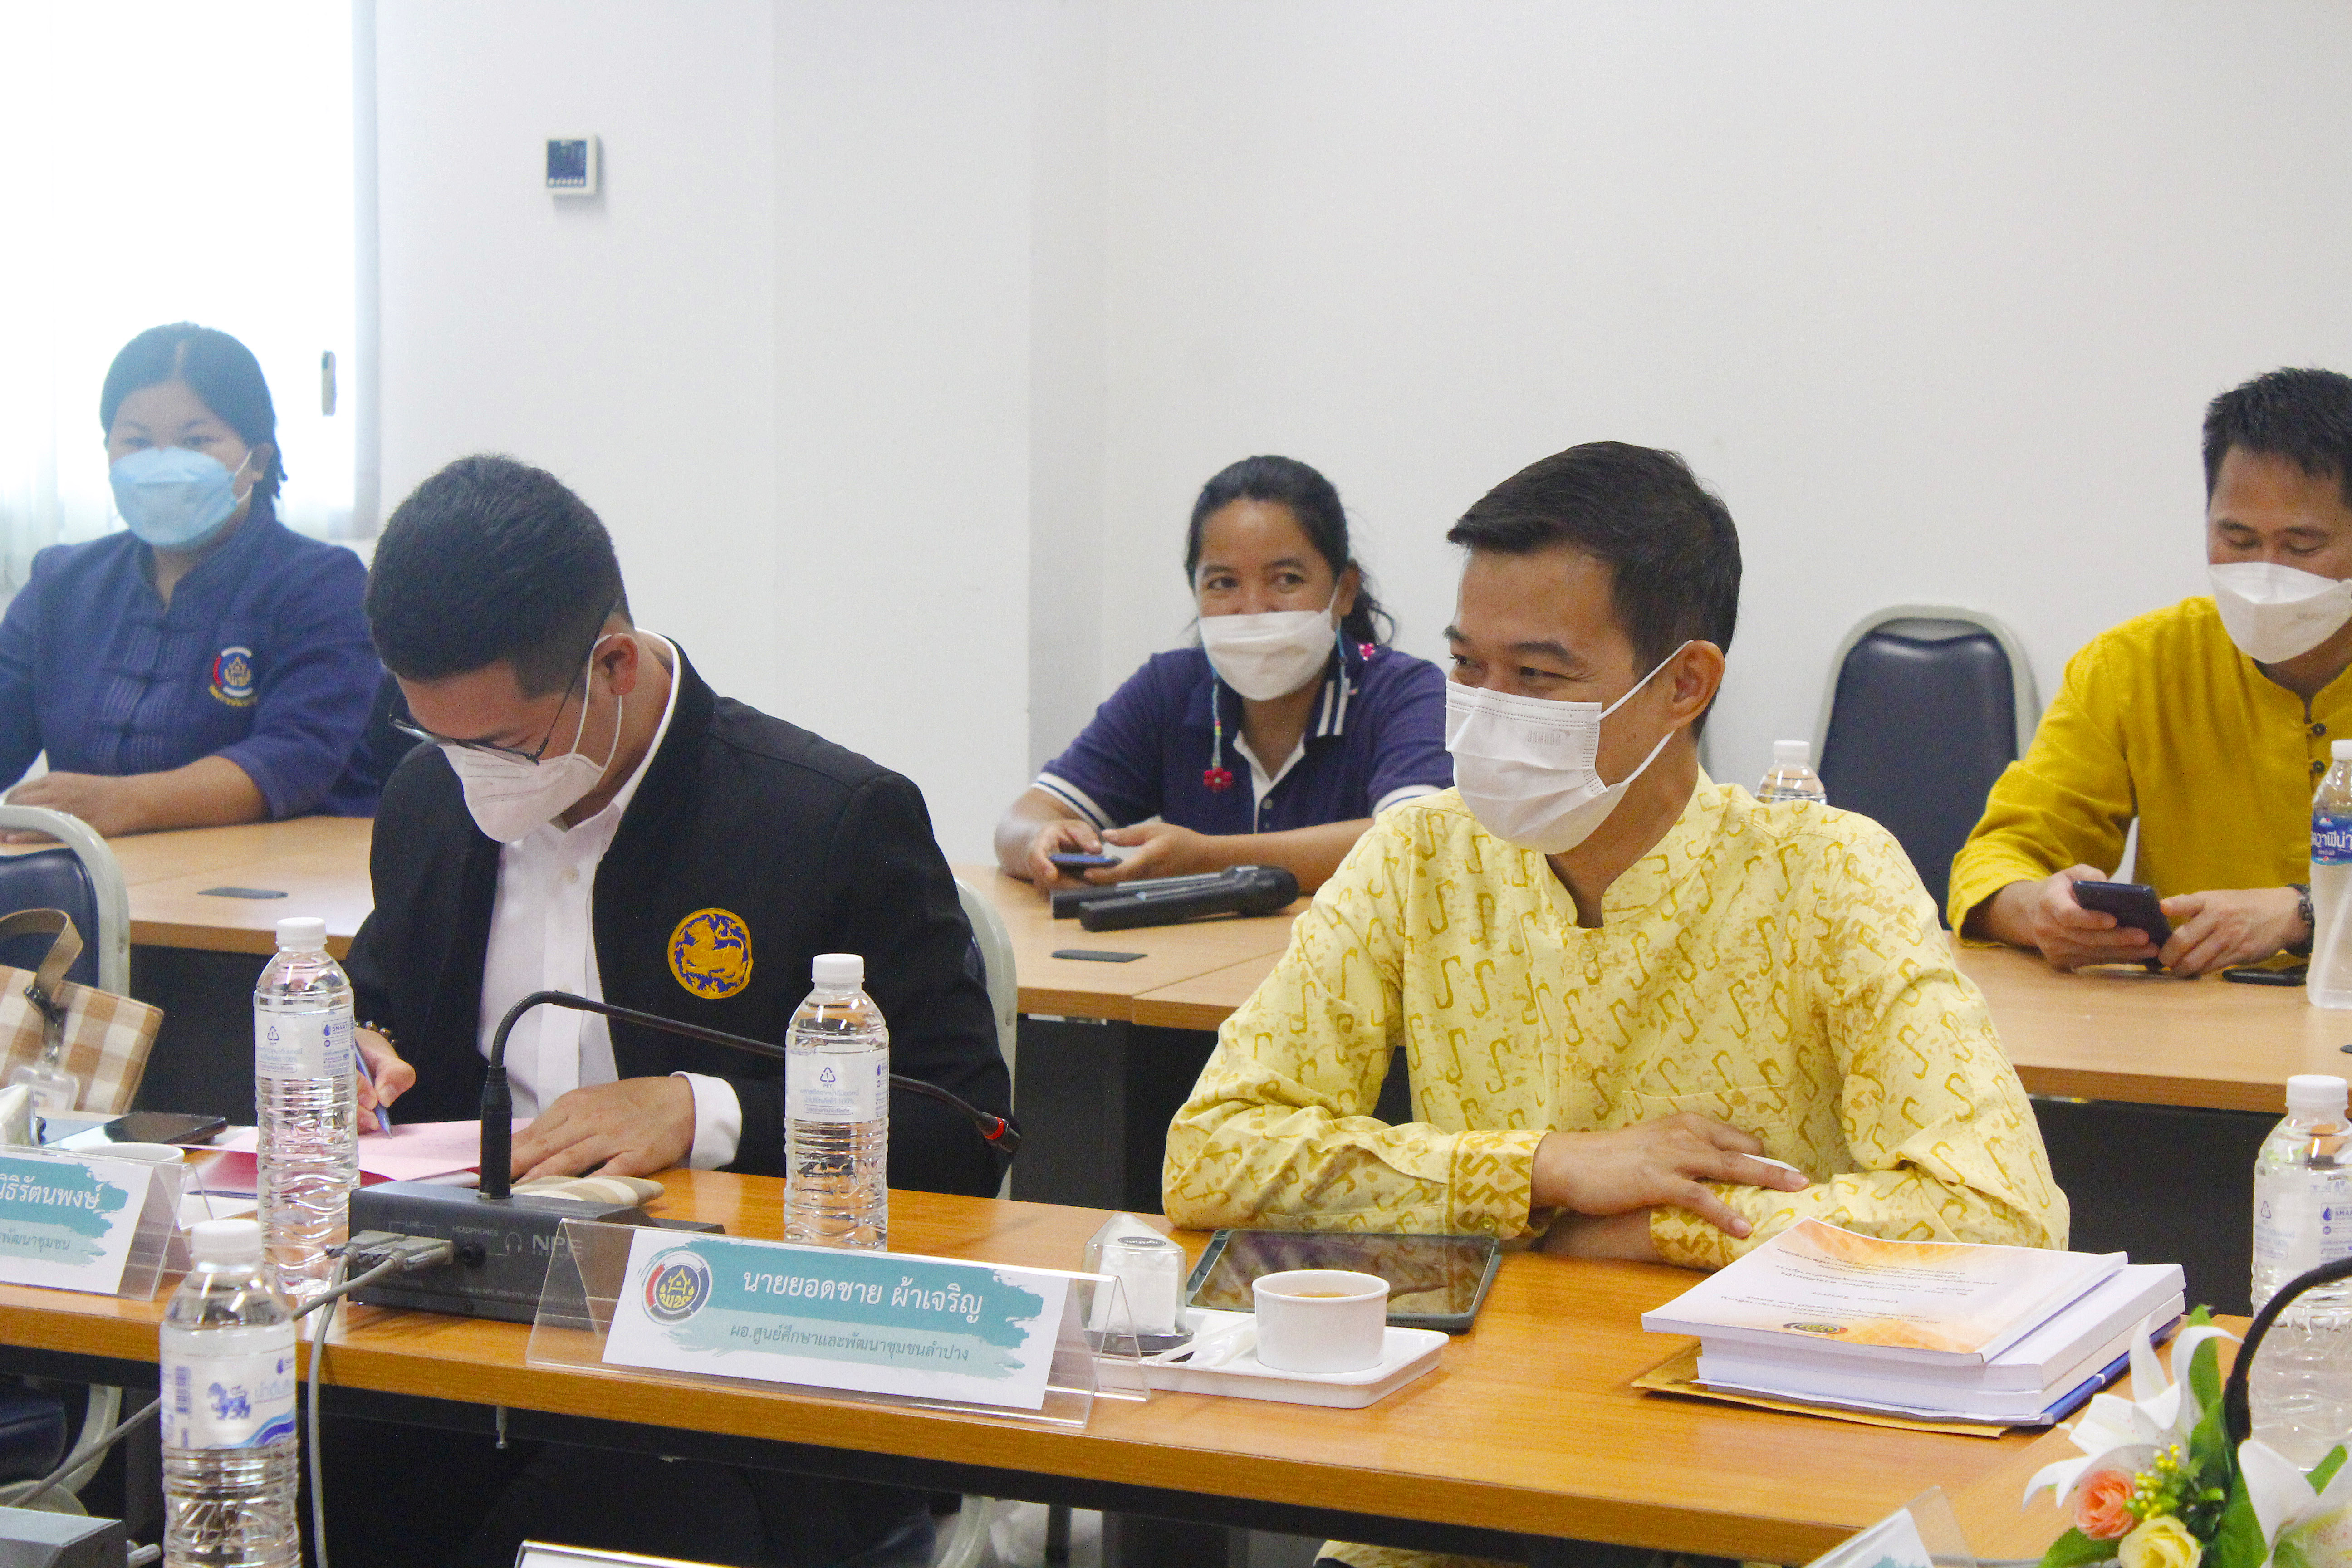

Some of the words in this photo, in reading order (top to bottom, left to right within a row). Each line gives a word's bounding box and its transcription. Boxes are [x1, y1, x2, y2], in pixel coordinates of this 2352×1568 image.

[452, 1225, 498, 1237] HEADPHONES
[743, 1271, 883, 1304] นายยอดชาย
[891, 1276, 984, 1323] ผ้าเจริญ
